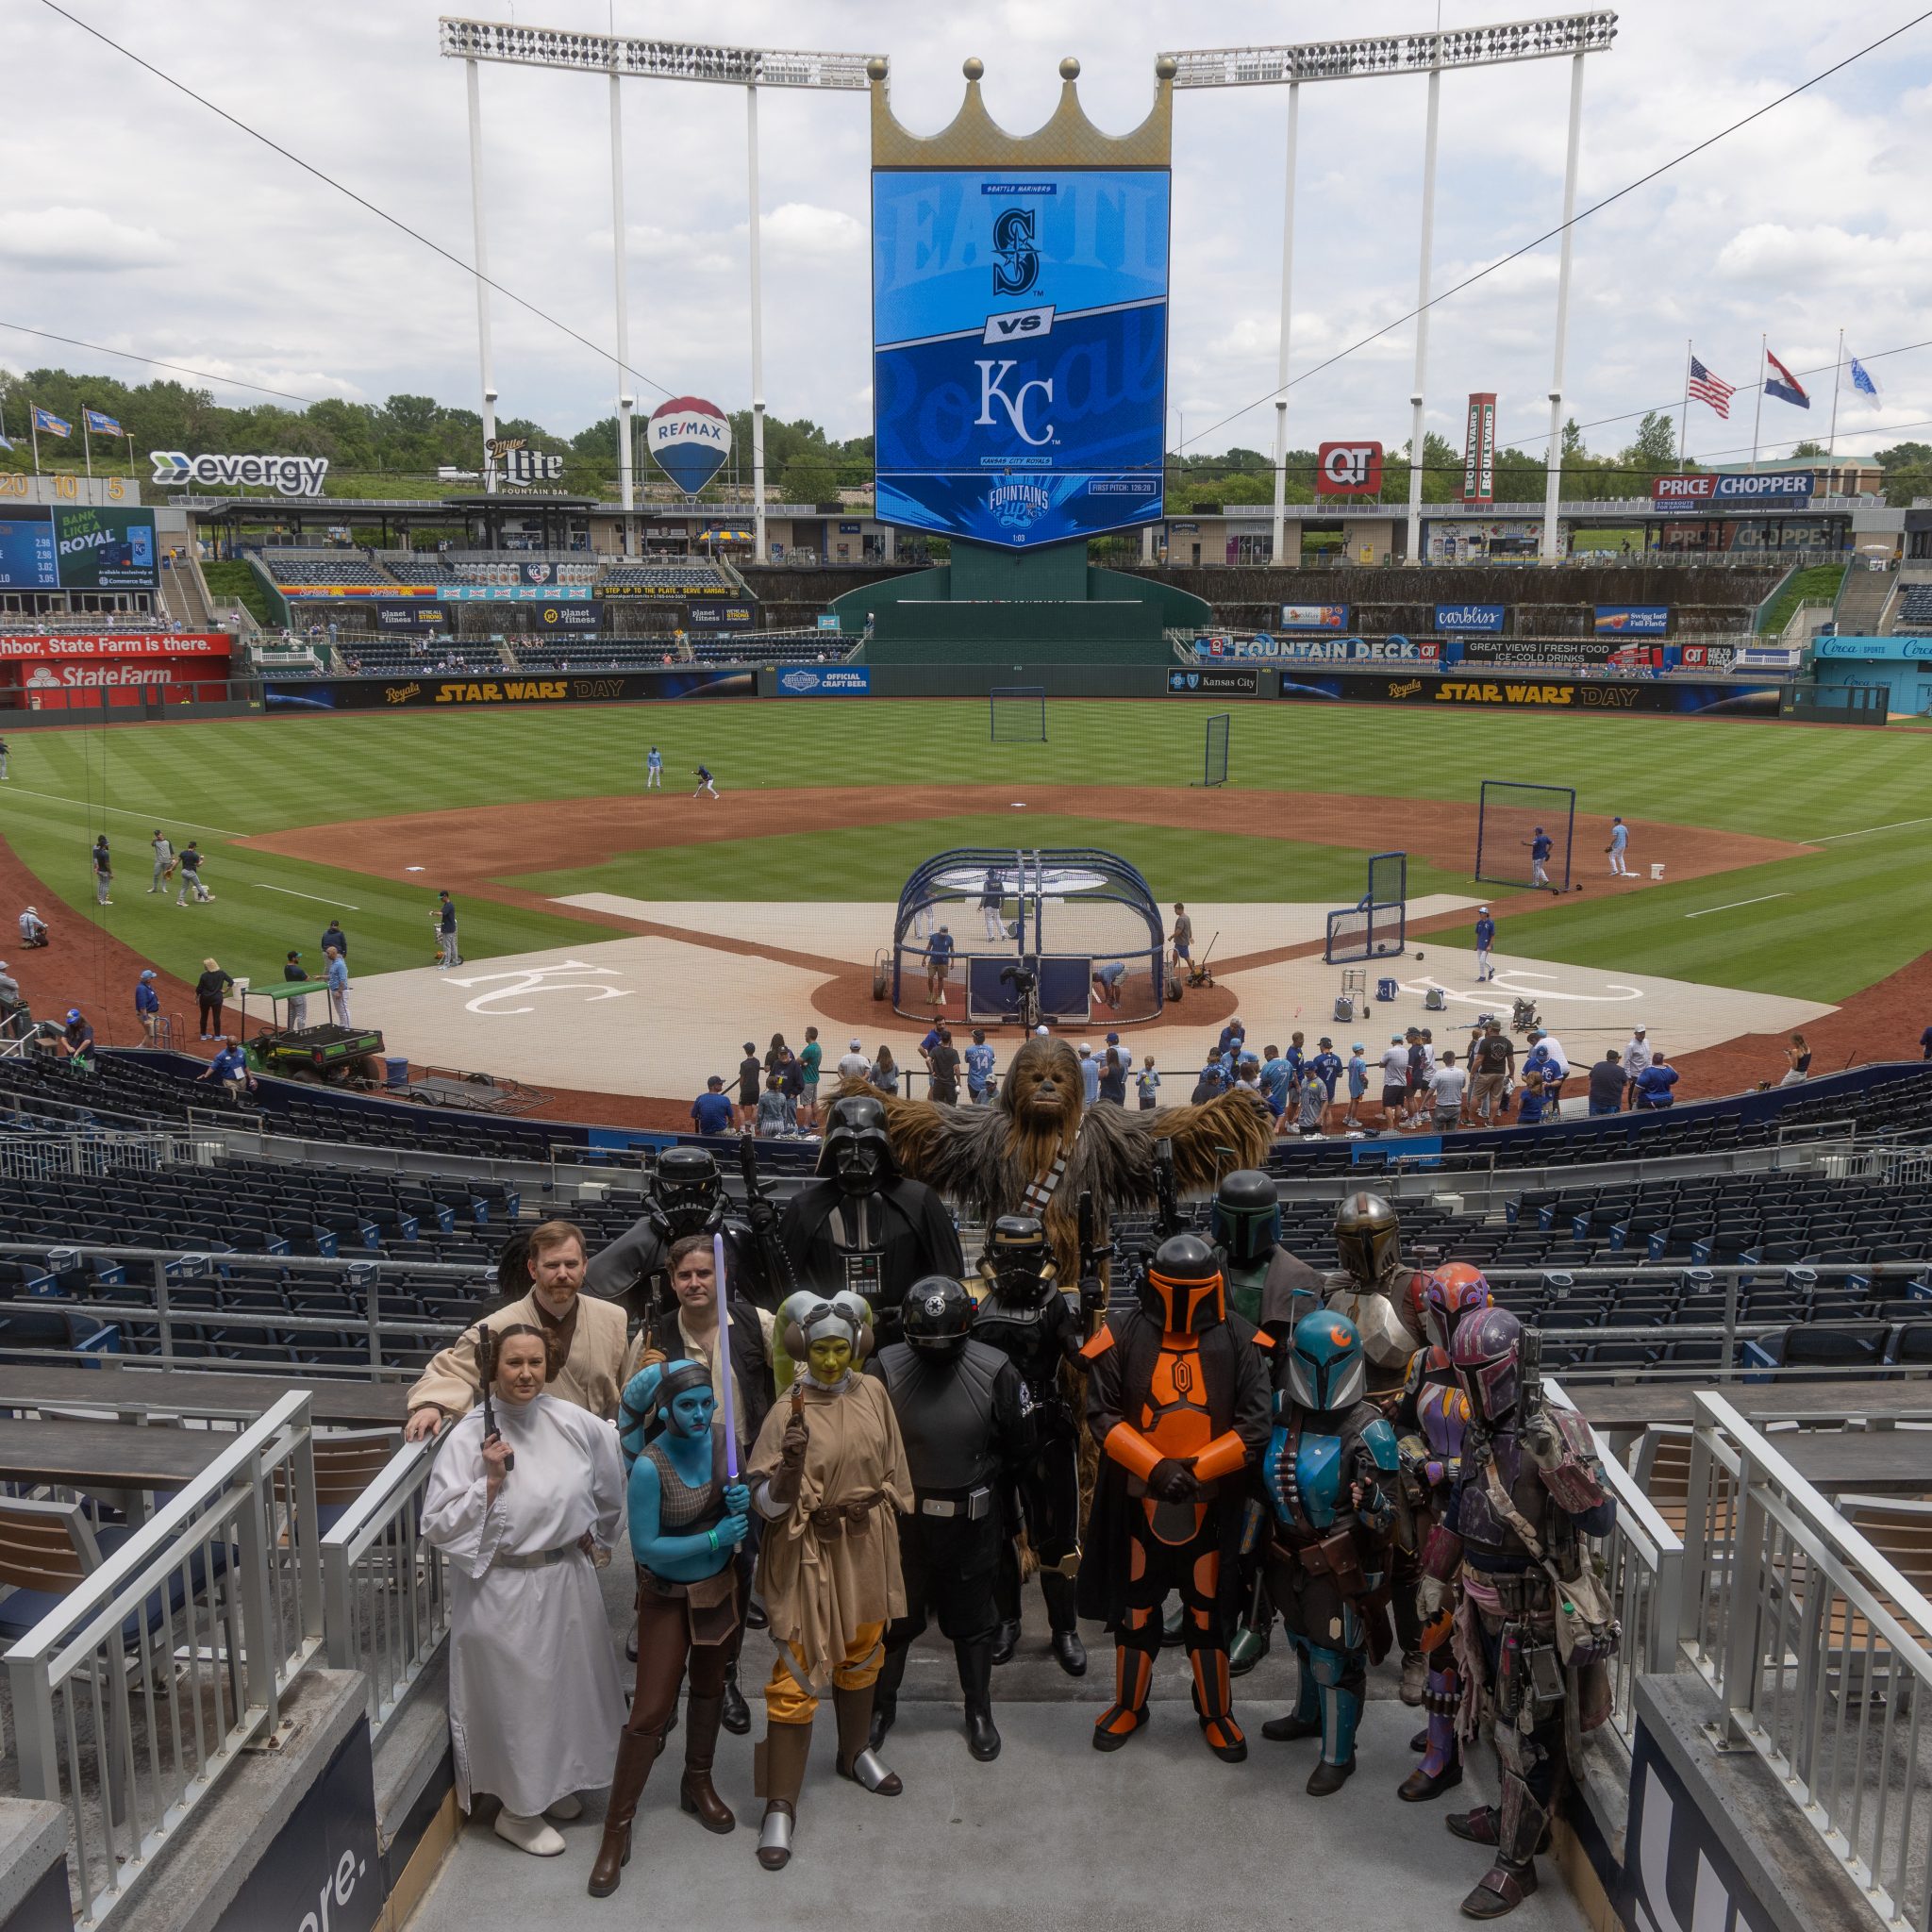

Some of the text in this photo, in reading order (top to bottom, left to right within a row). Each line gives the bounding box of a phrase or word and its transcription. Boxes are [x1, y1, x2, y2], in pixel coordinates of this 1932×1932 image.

[997, 315, 1041, 335] VS
[974, 359, 1054, 445] KC
[658, 422, 722, 441] RE/MAX
[486, 438, 527, 459] Miller
[1466, 411, 1478, 490] BOULEVARD
[1481, 411, 1492, 490] BOULEVARD
[196, 457, 326, 494] evergy
[505, 448, 564, 487] Lite
[1324, 447, 1372, 486] QT
[51, 475, 78, 499] 10
[108, 476, 125, 500] 5
[1658, 476, 1807, 495] PRICE CHOPPER
[990, 484, 1048, 510] FOUNTAINS
[62, 509, 97, 526] BANK
[63, 524, 91, 539] LIKE
[92, 521, 102, 533] A
[59, 529, 116, 556] ROYAL
[528, 568, 540, 577] KC
[299, 588, 329, 597] Surfside
[370, 588, 399, 597] Surfside
[381, 609, 407, 619] planet
[385, 615, 412, 624] fitness
[560, 609, 590, 619] planet
[565, 615, 596, 624] fitness
[692, 609, 716, 618] planet
[695, 614, 720, 623] fitness
[1439, 607, 1500, 625] carbliss
[1630, 611, 1668, 621] Swing Into
[0, 636, 211, 657] hbor, State Farm is there.
[1234, 641, 1416, 658] FOUNTAIN DECK
[1421, 645, 1436, 658] QT
[1470, 642, 1609, 654] GREAT VIEWS FRESH FOOD
[1685, 648, 1704, 663] QT
[1822, 638, 1857, 657] Circa
[1495, 653, 1585, 663] ICE-COLD DRINKS
[436, 679, 625, 703] STAR WARS DAY
[1203, 676, 1256, 689] Kansas City
[1388, 679, 1423, 697] Royals
[386, 681, 421, 704] Royals
[1435, 683, 1640, 707] STAR WARS DAY
[975, 1056, 989, 1070] 14
[1325, 1066, 1334, 1081] 7
[1542, 1067, 1554, 1080] KC
